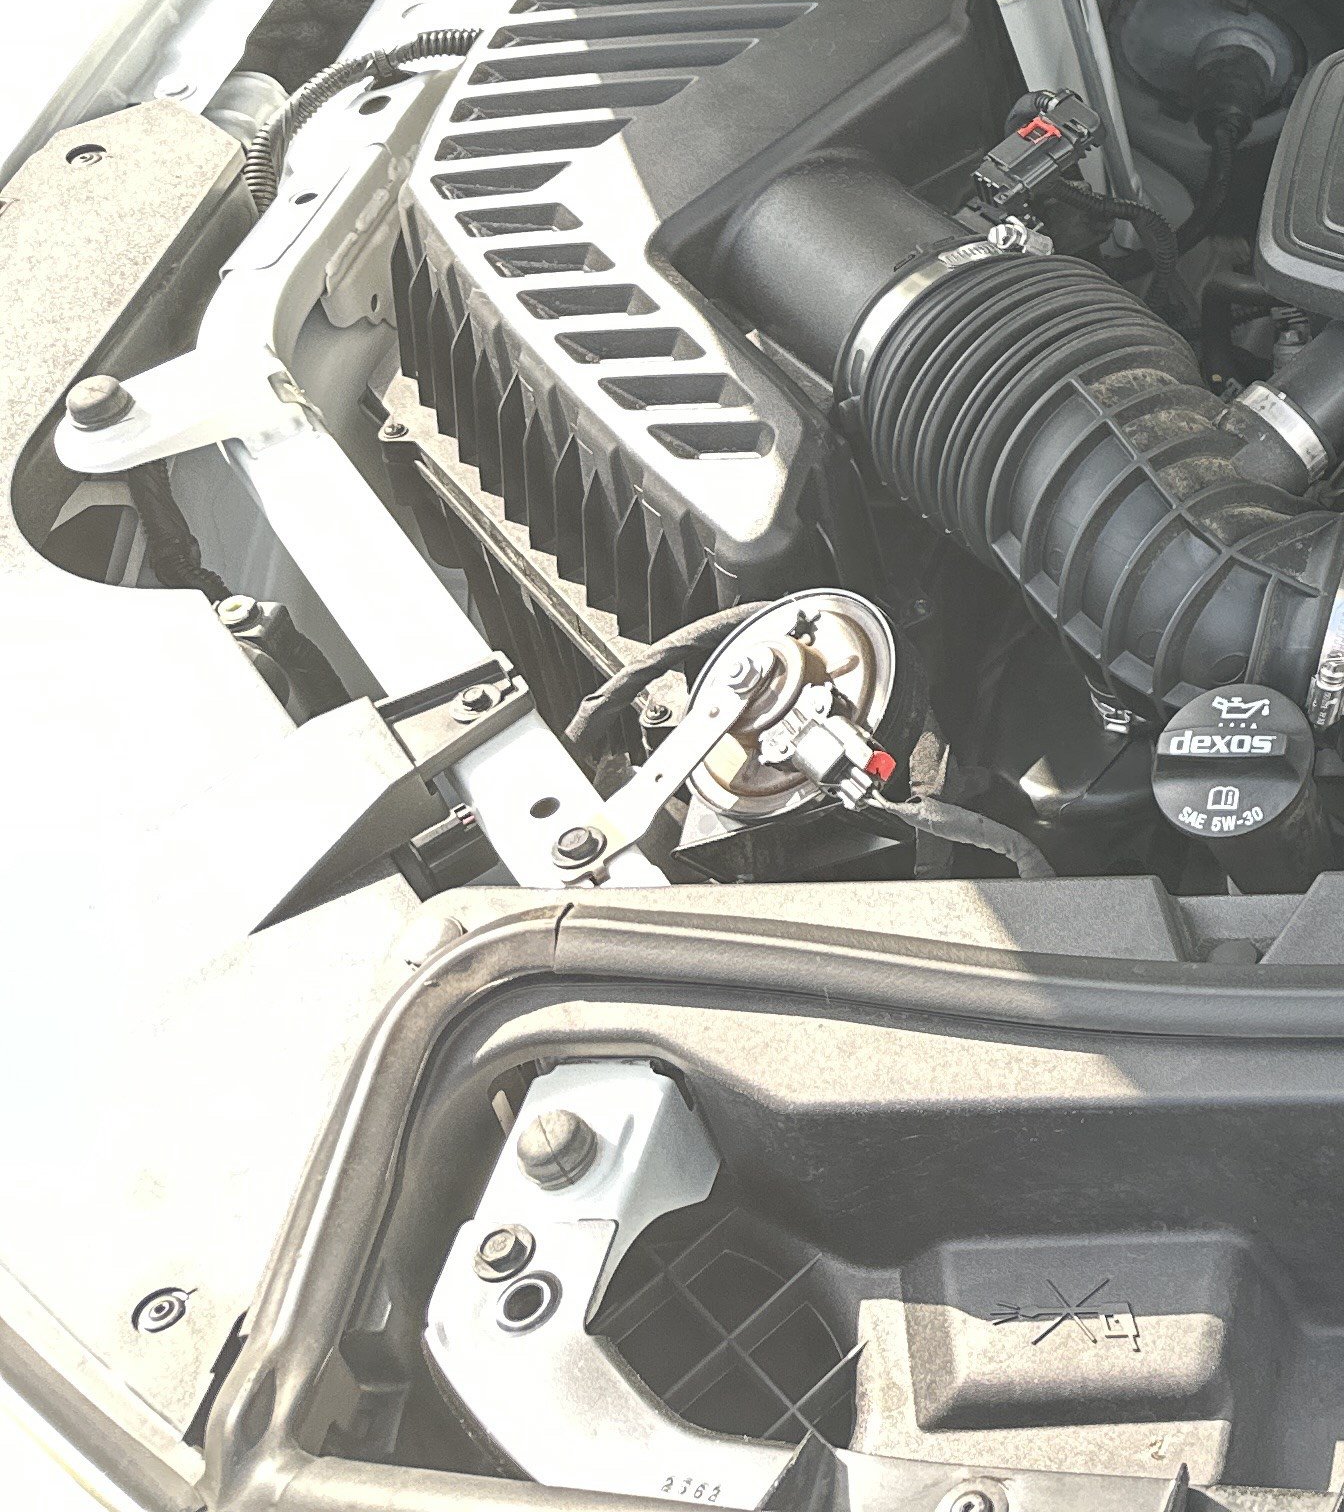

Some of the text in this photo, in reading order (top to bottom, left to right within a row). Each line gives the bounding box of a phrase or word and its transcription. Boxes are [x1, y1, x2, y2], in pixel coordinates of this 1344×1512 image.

[1169, 730, 1275, 755] dexos
[1178, 806, 1264, 832] SAE 5W-30
